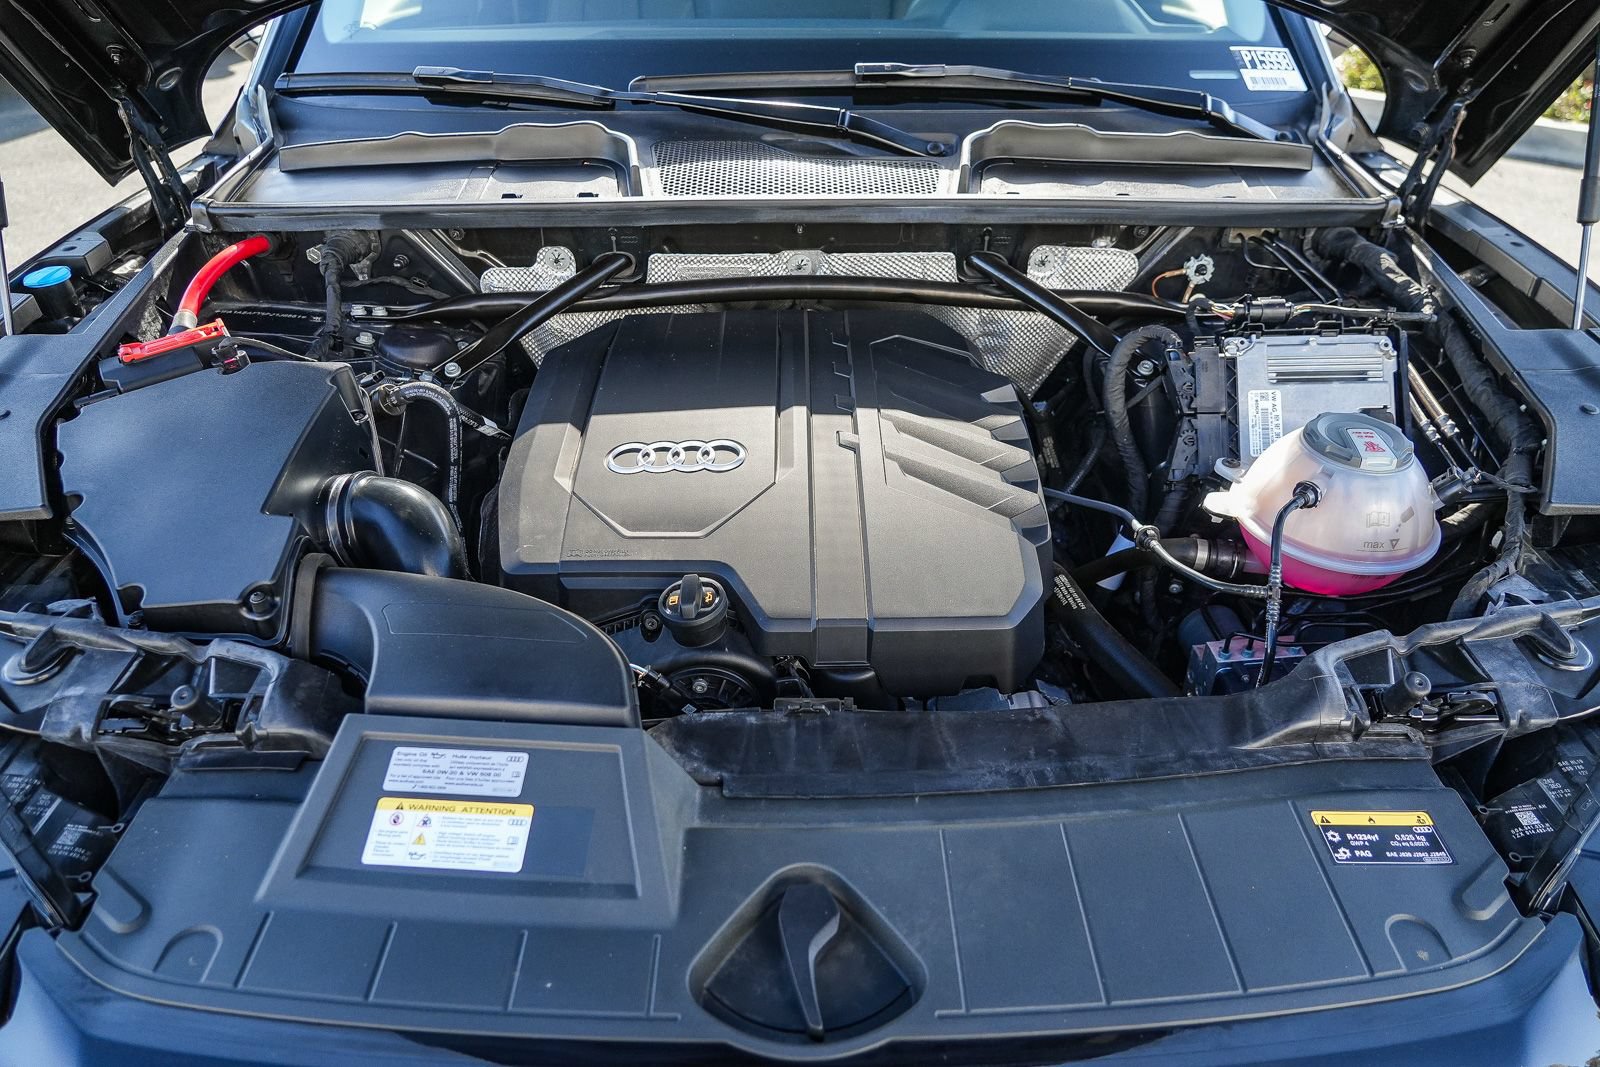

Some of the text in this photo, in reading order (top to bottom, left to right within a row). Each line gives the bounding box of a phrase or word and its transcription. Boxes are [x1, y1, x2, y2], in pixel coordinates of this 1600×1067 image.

[1271, 391, 1277, 402] VW
[1271, 403, 1278, 413] AG
[1363, 541, 1385, 549] max
[408, 803, 516, 816] WARNING ATTENTION
[1415, 834, 1427, 842] kg
[1355, 850, 1373, 858] PAG
